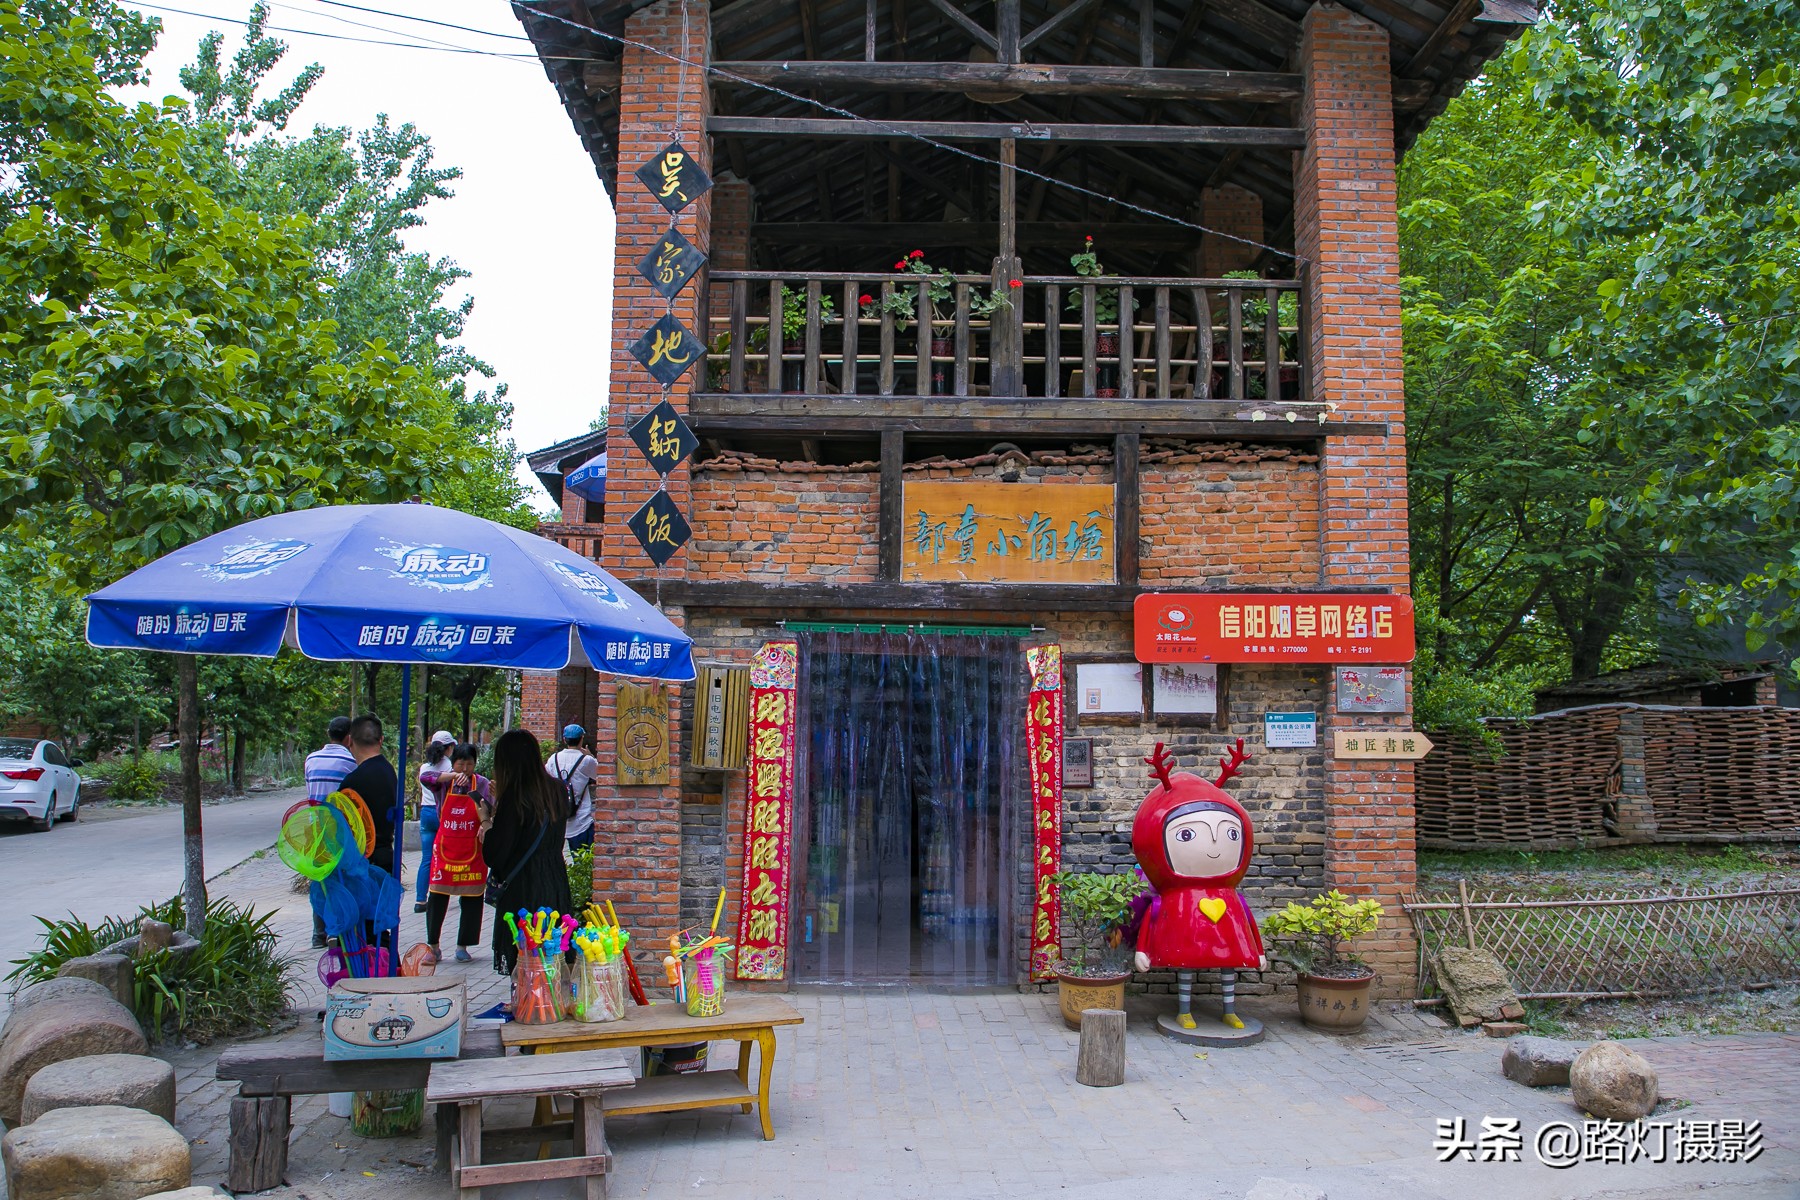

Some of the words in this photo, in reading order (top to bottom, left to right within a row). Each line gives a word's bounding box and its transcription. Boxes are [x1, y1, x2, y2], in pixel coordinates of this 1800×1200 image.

[399, 553, 486, 576] 脉动
[1219, 605, 1393, 639] 信阳烟草网络店
[1156, 633, 1180, 641] 太阳花
[707, 694, 721, 758] 旧电池回收箱
[1303, 992, 1360, 1011] 吉祥如意
